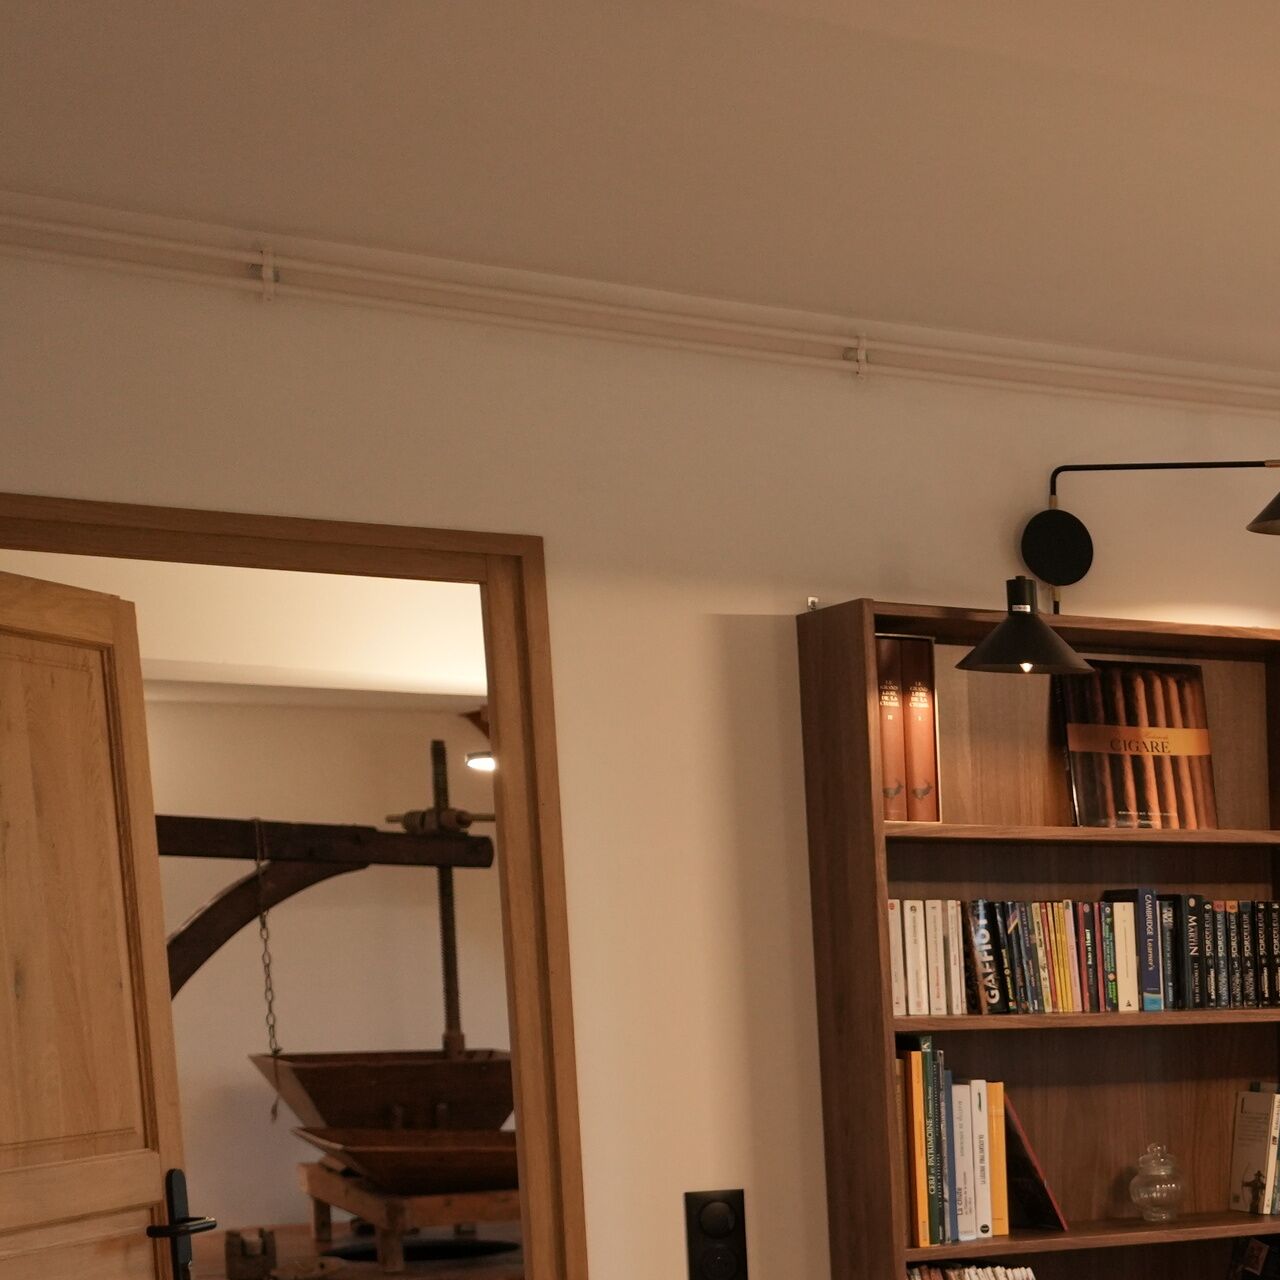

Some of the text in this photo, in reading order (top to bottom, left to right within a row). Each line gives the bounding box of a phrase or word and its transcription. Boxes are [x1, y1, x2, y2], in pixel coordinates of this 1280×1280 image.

[1109, 739, 1172, 754] CIGARE
[1144, 894, 1154, 972] CAMBRIDGE Learner's
[1187, 915, 1199, 957] MARTIN
[1204, 911, 1214, 957] SORCELEUR
[1216, 913, 1226, 957] SORCELEUR
[1230, 913, 1240, 958] SORCELEUR
[1243, 914, 1253, 957] SORCELEUR
[1257, 912, 1267, 956] SORCELEUR
[976, 917, 1001, 1004] GAFFIOT
[926, 1120, 935, 1167] PATRIMOINE
